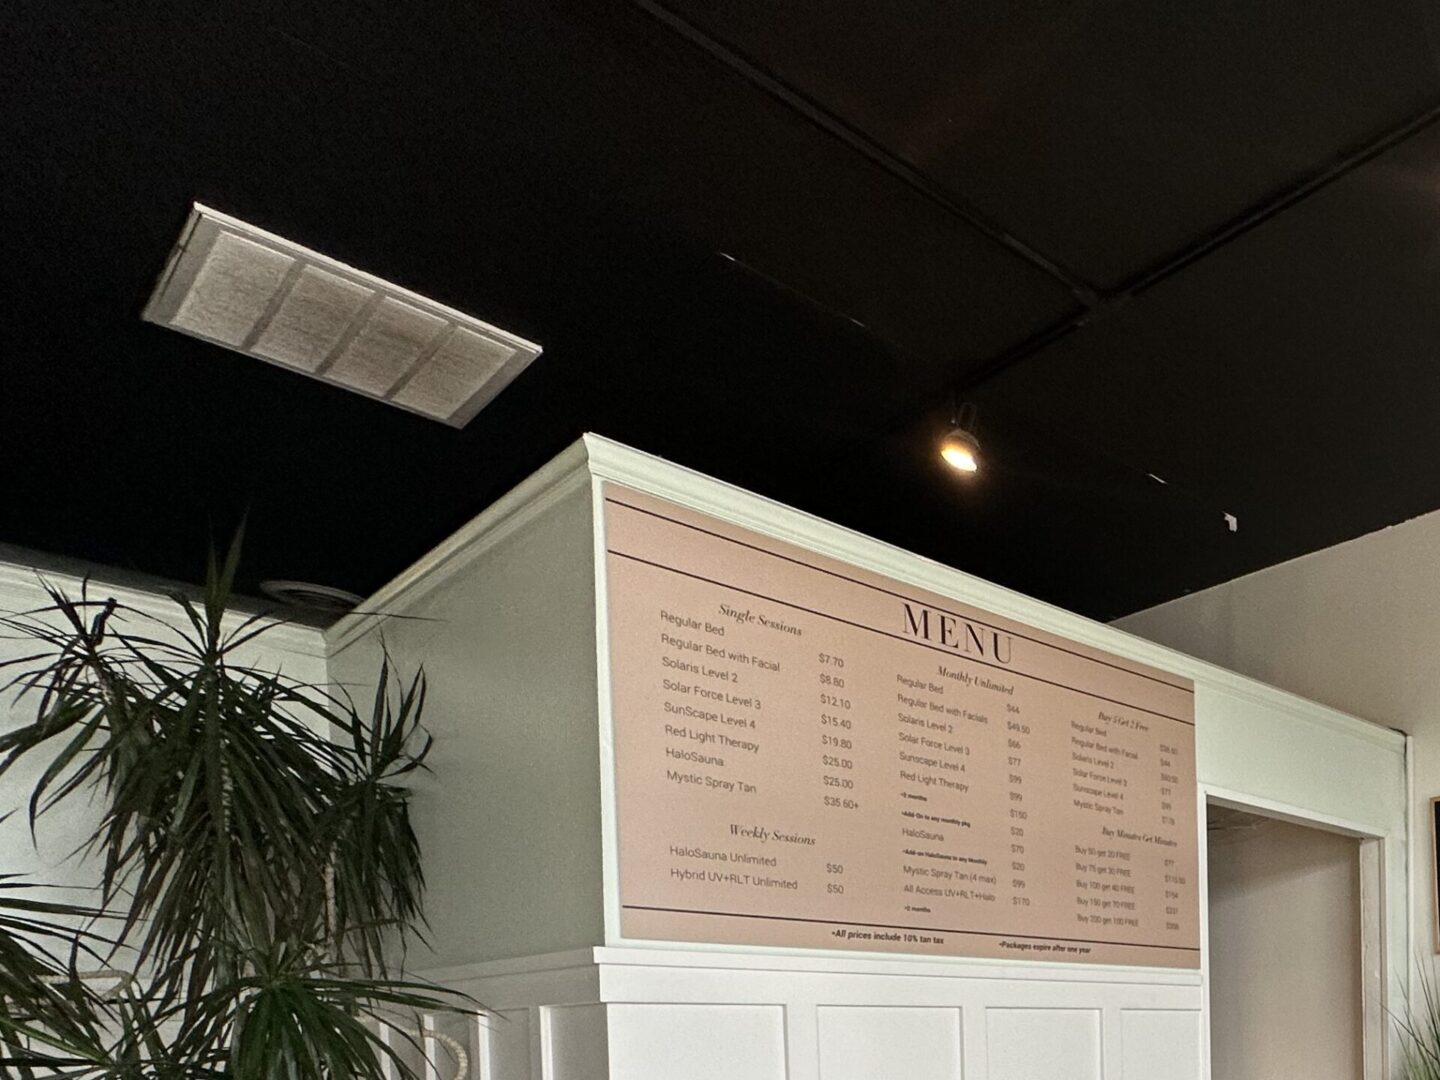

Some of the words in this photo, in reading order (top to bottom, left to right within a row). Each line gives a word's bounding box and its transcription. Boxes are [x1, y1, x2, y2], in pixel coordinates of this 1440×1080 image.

[719, 604, 755, 624] Single
[759, 615, 802, 636] Sessions
[661, 610, 702, 629] Regular
[705, 623, 724, 636] Bed
[819, 653, 844, 668] $7.70
[903, 603, 1014, 665] MENU
[661, 633, 703, 652] Regular
[706, 645, 725, 658] Bed
[728, 653, 749, 663] with
[752, 656, 780, 672] Facial
[820, 673, 844, 688] $8.80
[662, 656, 699, 673] Solaris
[702, 666, 728, 680] Level
[732, 673, 738, 683] 2
[821, 694, 851, 709] $12.10
[897, 674, 926, 689] Regular
[929, 683, 943, 694] Bed
[937, 666, 973, 687] Monthly
[975, 676, 1014, 695] Unlimited
[663, 679, 691, 693] Solar
[694, 686, 723, 701] Force
[726, 693, 752, 707] Level
[755, 700, 761, 710] 3
[821, 714, 851, 729] $15.40
[898, 693, 927, 708] Regular
[930, 702, 944, 712] Bed
[946, 708, 961, 717] with
[664, 702, 718, 721] SunScape
[721, 714, 747, 727] Level
[750, 720, 755, 728] 4
[822, 735, 852, 749] $19.80
[898, 713, 925, 727] Solaris
[927, 720, 946, 731] Level
[948, 725, 953, 734] 2
[665, 724, 686, 737] Red
[689, 730, 715, 744] Light
[718, 735, 759, 753] Therapy
[823, 755, 852, 769] $25.00
[899, 732, 919, 744] Solar
[921, 737, 942, 748] Force
[944, 742, 963, 753] Level
[965, 747, 970, 755] 3
[666, 747, 724, 766] HaloSauna
[823, 776, 853, 789] $25.00
[939, 760, 959, 770] Level
[960, 764, 965, 772] 4
[667, 770, 702, 785] Mystic
[705, 776, 734, 792] Spray
[738, 782, 756, 792] Tan
[900, 771, 915, 781] Red
[918, 775, 936, 786] Light
[939, 778, 969, 793] Therapy
[730, 824, 770, 840] Weekly
[772, 831, 816, 845] Sessions
[902, 828, 944, 841] HaloSauna
[670, 846, 727, 861] HaloSauna
[730, 853, 776, 866] Unlimited
[826, 863, 843, 874] $50
[903, 865, 929, 877] Mystic
[931, 869, 952, 880] Spray
[954, 871, 968, 880] Tan
[671, 868, 705, 881] Hybrid
[708, 872, 750, 884] UV+RLT
[753, 877, 797, 889] Unlimited
[827, 883, 844, 894] $50
[916, 886, 943, 896] Access
[848, 931, 871, 940] prices
[874, 933, 901, 941] include
[904, 934, 918, 942] 10%
